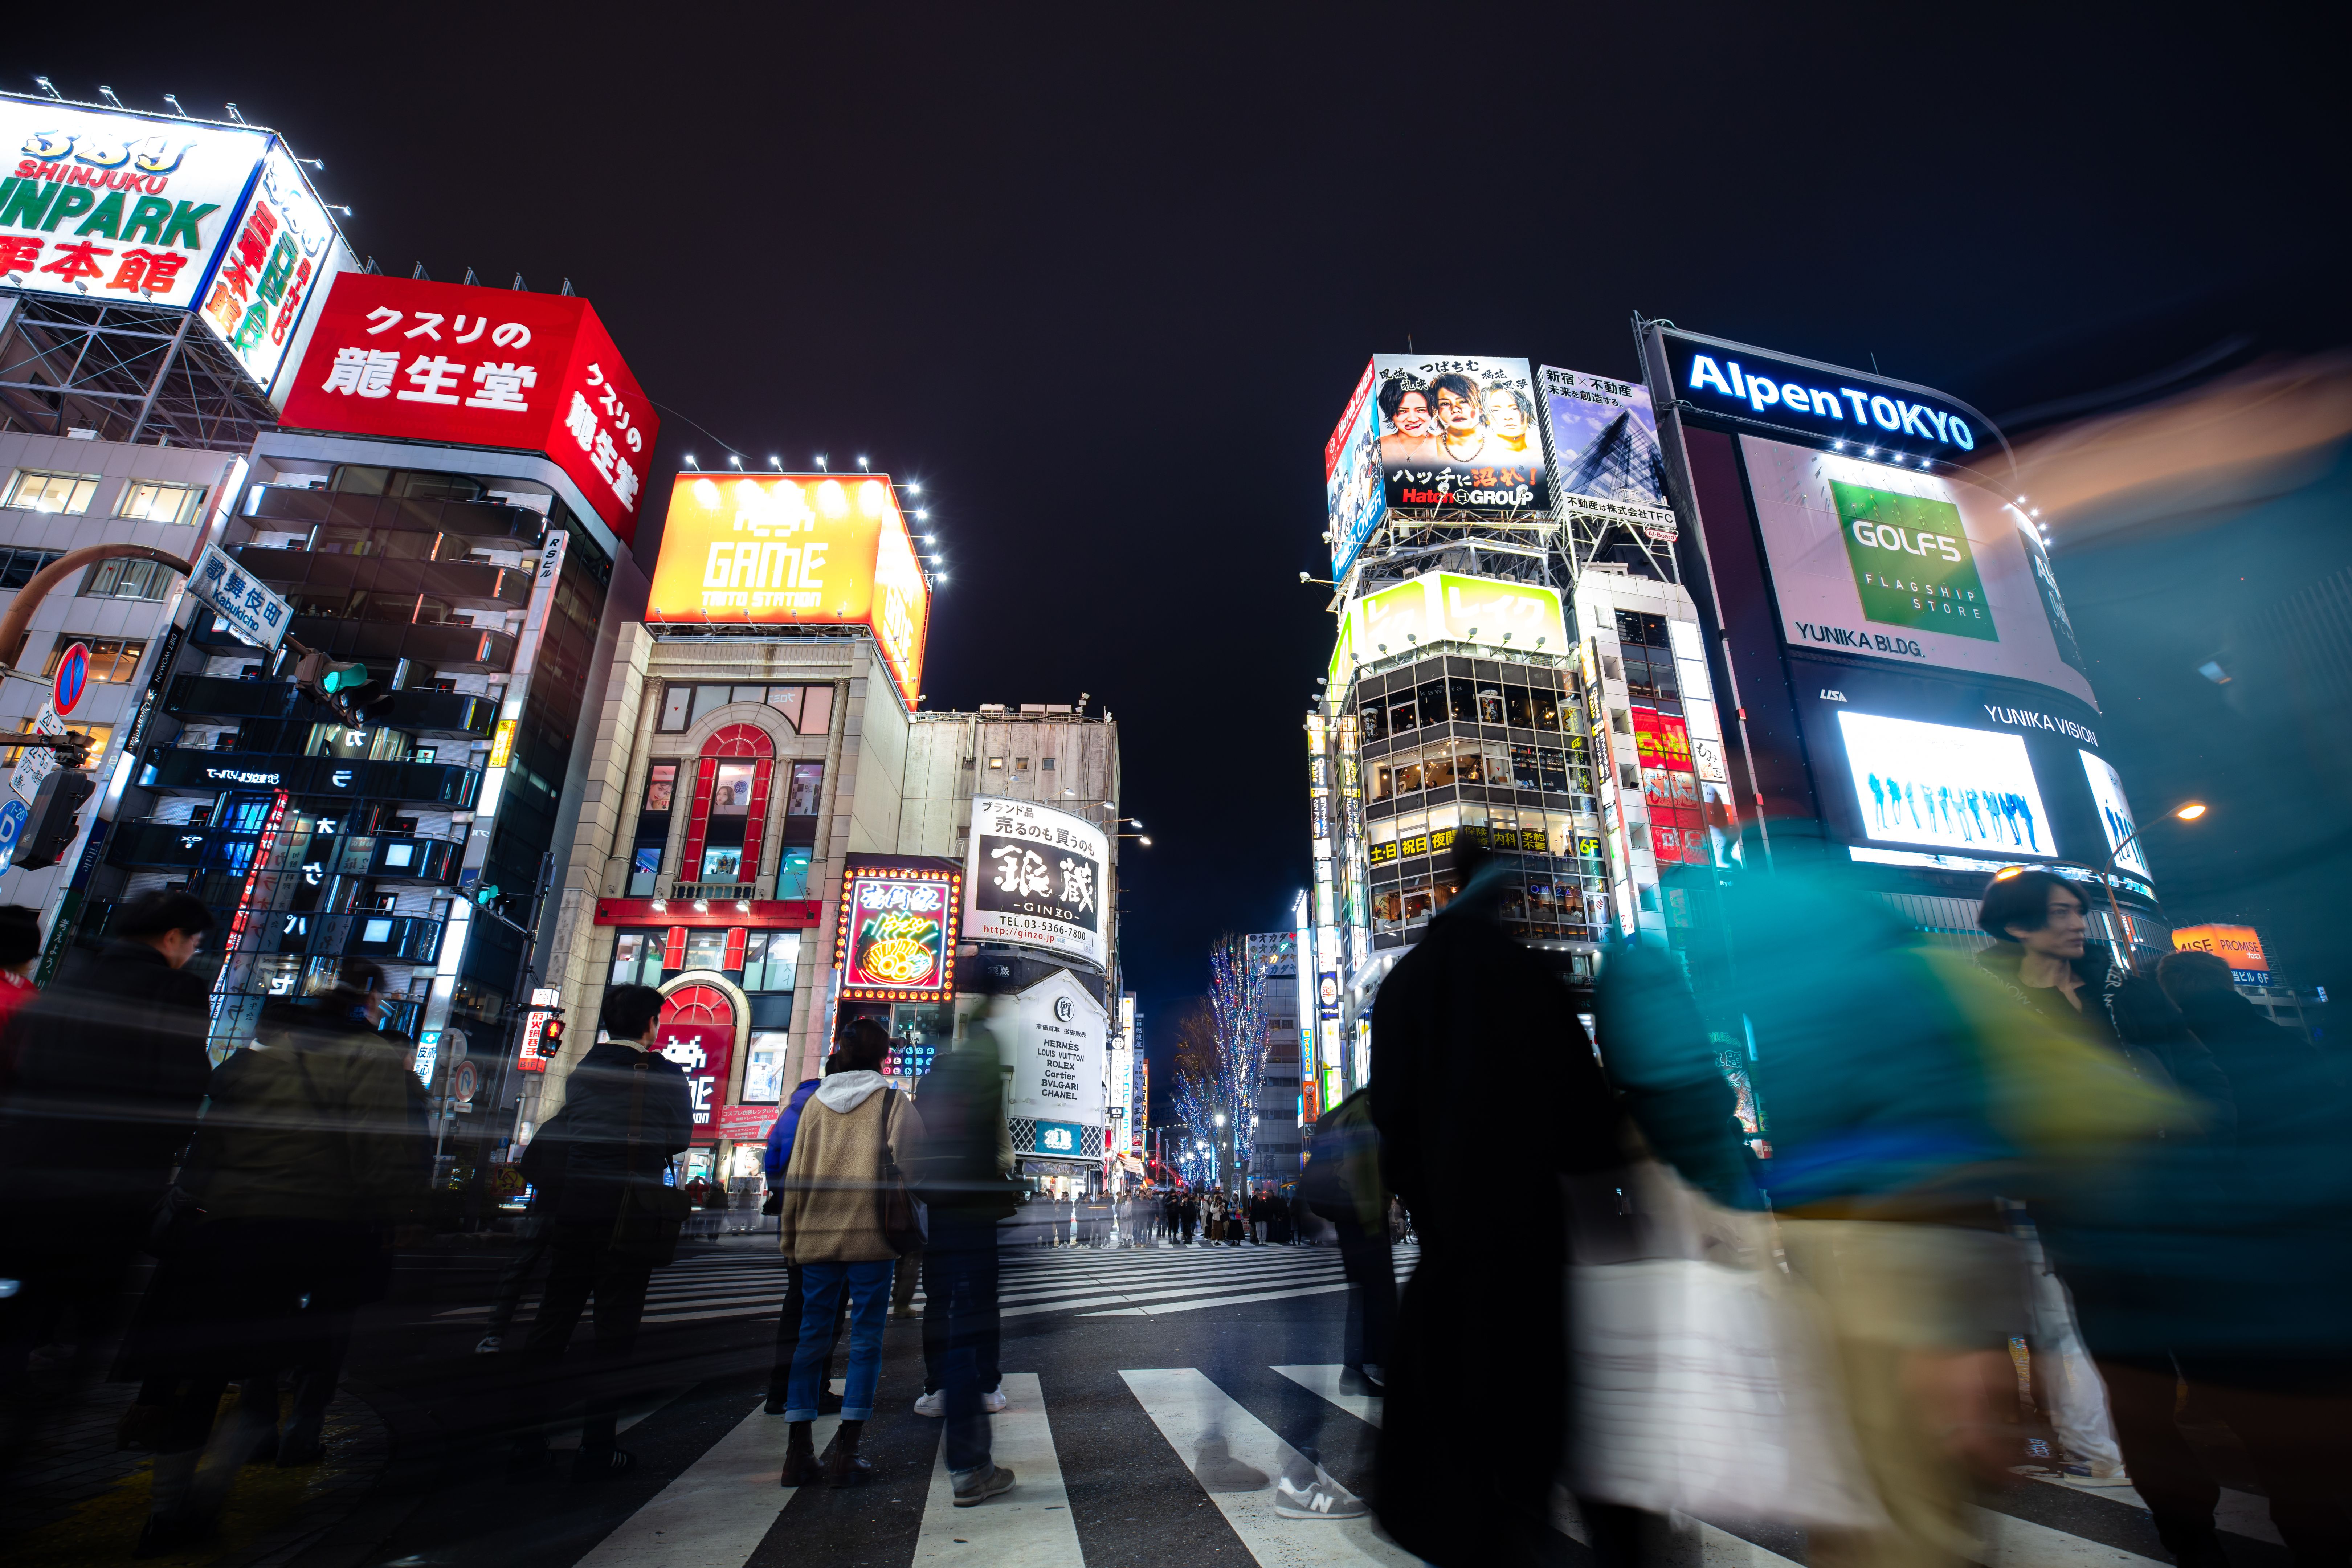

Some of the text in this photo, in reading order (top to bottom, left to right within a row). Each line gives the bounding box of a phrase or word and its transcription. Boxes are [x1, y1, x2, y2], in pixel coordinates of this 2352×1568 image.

[15, 160, 168, 195] SHINJUKU
[232, 231, 299, 366] SUNPARK
[271, 258, 312, 346] SHINJUKU
[365, 306, 532, 349] クスリの
[1419, 360, 1479, 373] つばちむ
[321, 346, 538, 412] 龍生堂
[1502, 378, 1528, 391] 黒夢
[1338, 363, 1373, 440] Hatch OVER
[1548, 384, 1624, 408] 未来を創造する。
[1689, 354, 1974, 451] Alpen TOKYO
[586, 363, 642, 453] クスリの
[564, 391, 639, 513] 龍生堂
[1470, 490, 1534, 505] GROUP
[1621, 488, 1641, 500] TFC
[1357, 490, 1382, 538] OVER
[1566, 495, 1673, 524] 不動産は株式会社TFC
[1648, 531, 1675, 540] AI-Board
[1853, 520, 1961, 562] GOLF5
[703, 542, 829, 588] GAME
[205, 556, 283, 628] 歌舞伎町
[1865, 573, 1975, 601] FLAGSHIP
[702, 591, 821, 607] TAITO STATION
[1448, 586, 1545, 626] レイク
[1912, 598, 1981, 619] STORE
[212, 588, 260, 631] Kabukicho
[1795, 622, 1926, 659] YUNIKA BLDG.
[155, 633, 178, 683] DIET WOMAN
[1420, 685, 1463, 697] kawara
[1820, 689, 1847, 702] LISA
[1592, 687, 1601, 720] Cheese
[136, 701, 152, 729] Queen's
[1984, 705, 2099, 747] YUNIKA VISION
[14, 773, 25, 792] を除く
[10, 802, 25, 821] 7-20
[982, 802, 1034, 818] ブランド品
[1465, 826, 1487, 836] 保険
[1494, 832, 1517, 846] 内科
[1522, 832, 1545, 842] 予約
[1402, 836, 1427, 855] 祝日
[1432, 829, 1458, 848] 夜間
[1523, 841, 1546, 851] 不要
[1580, 837, 1598, 854] 6F
[82, 841, 101, 873] Vitule
[991, 845, 1094, 913] 銀蔵
[983, 925, 1054, 943] http://ginzo.jp
[1000, 916, 1086, 941] TEL.03-5366-7800
[1259, 932, 1297, 943] オカダヤ
[1085, 944, 1093, 953] 検索
[1259, 943, 1297, 954] オカダヤ
[2220, 939, 2260, 953] PROMISE
[1259, 954, 1297, 964] オカダヤ
[2257, 973, 2270, 984] 6F
[1322, 985, 1335, 997] 薬
[1060, 1001, 1072, 1018] 質
[1036, 1024, 1087, 1038] 高価買取 激安販売
[1135, 1028, 1143, 1048] 越後屋
[1044, 1039, 1079, 1051] HERMÈS
[1114, 1039, 1122, 1048] 質
[1038, 1048, 1084, 1062] LOUIS VUITTON
[1047, 1059, 1075, 1070] ROLEX
[1045, 1070, 1076, 1080] Cartier
[1041, 1079, 1079, 1091] BVLGARI
[1042, 1089, 1077, 1100] CHANEL
[1133, 1107, 1142, 1134] 三国一
